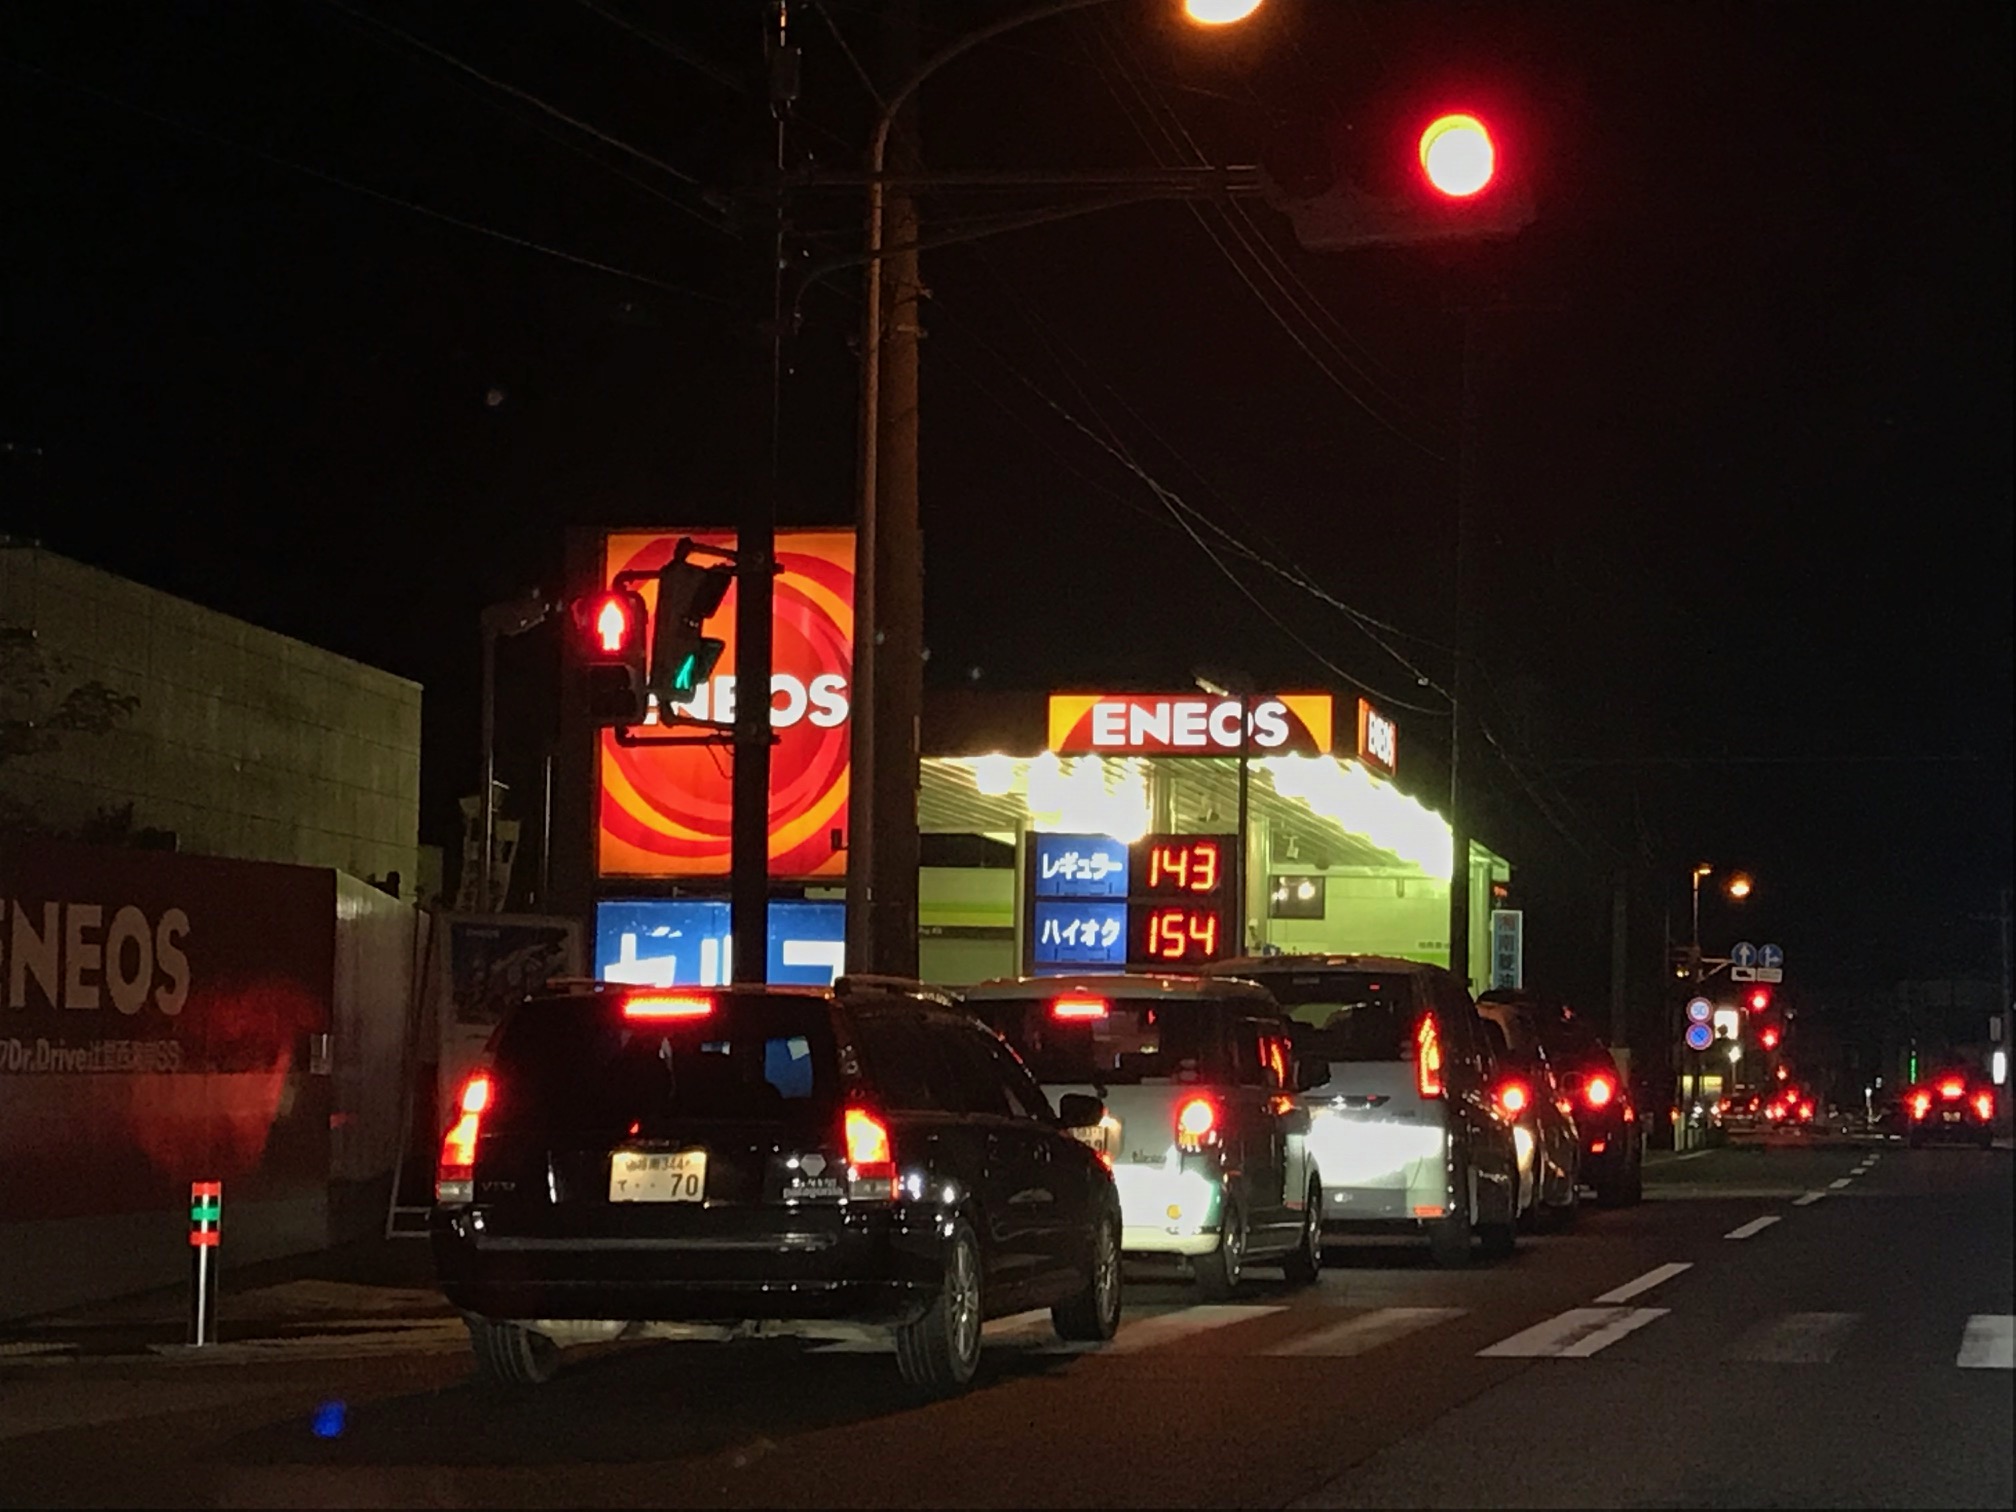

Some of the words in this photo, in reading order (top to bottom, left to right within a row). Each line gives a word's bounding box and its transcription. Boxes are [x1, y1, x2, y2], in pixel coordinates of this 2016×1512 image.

[642, 673, 850, 728] NEOS
[1092, 701, 1290, 748] ENEOS
[1041, 850, 1123, 881] レギュラー
[1149, 846, 1217, 891] 143
[1041, 917, 1121, 947] ハイオク
[1148, 913, 1217, 958] 154
[0, 898, 192, 1017] NEOS
[670, 1173, 699, 1197] 70
